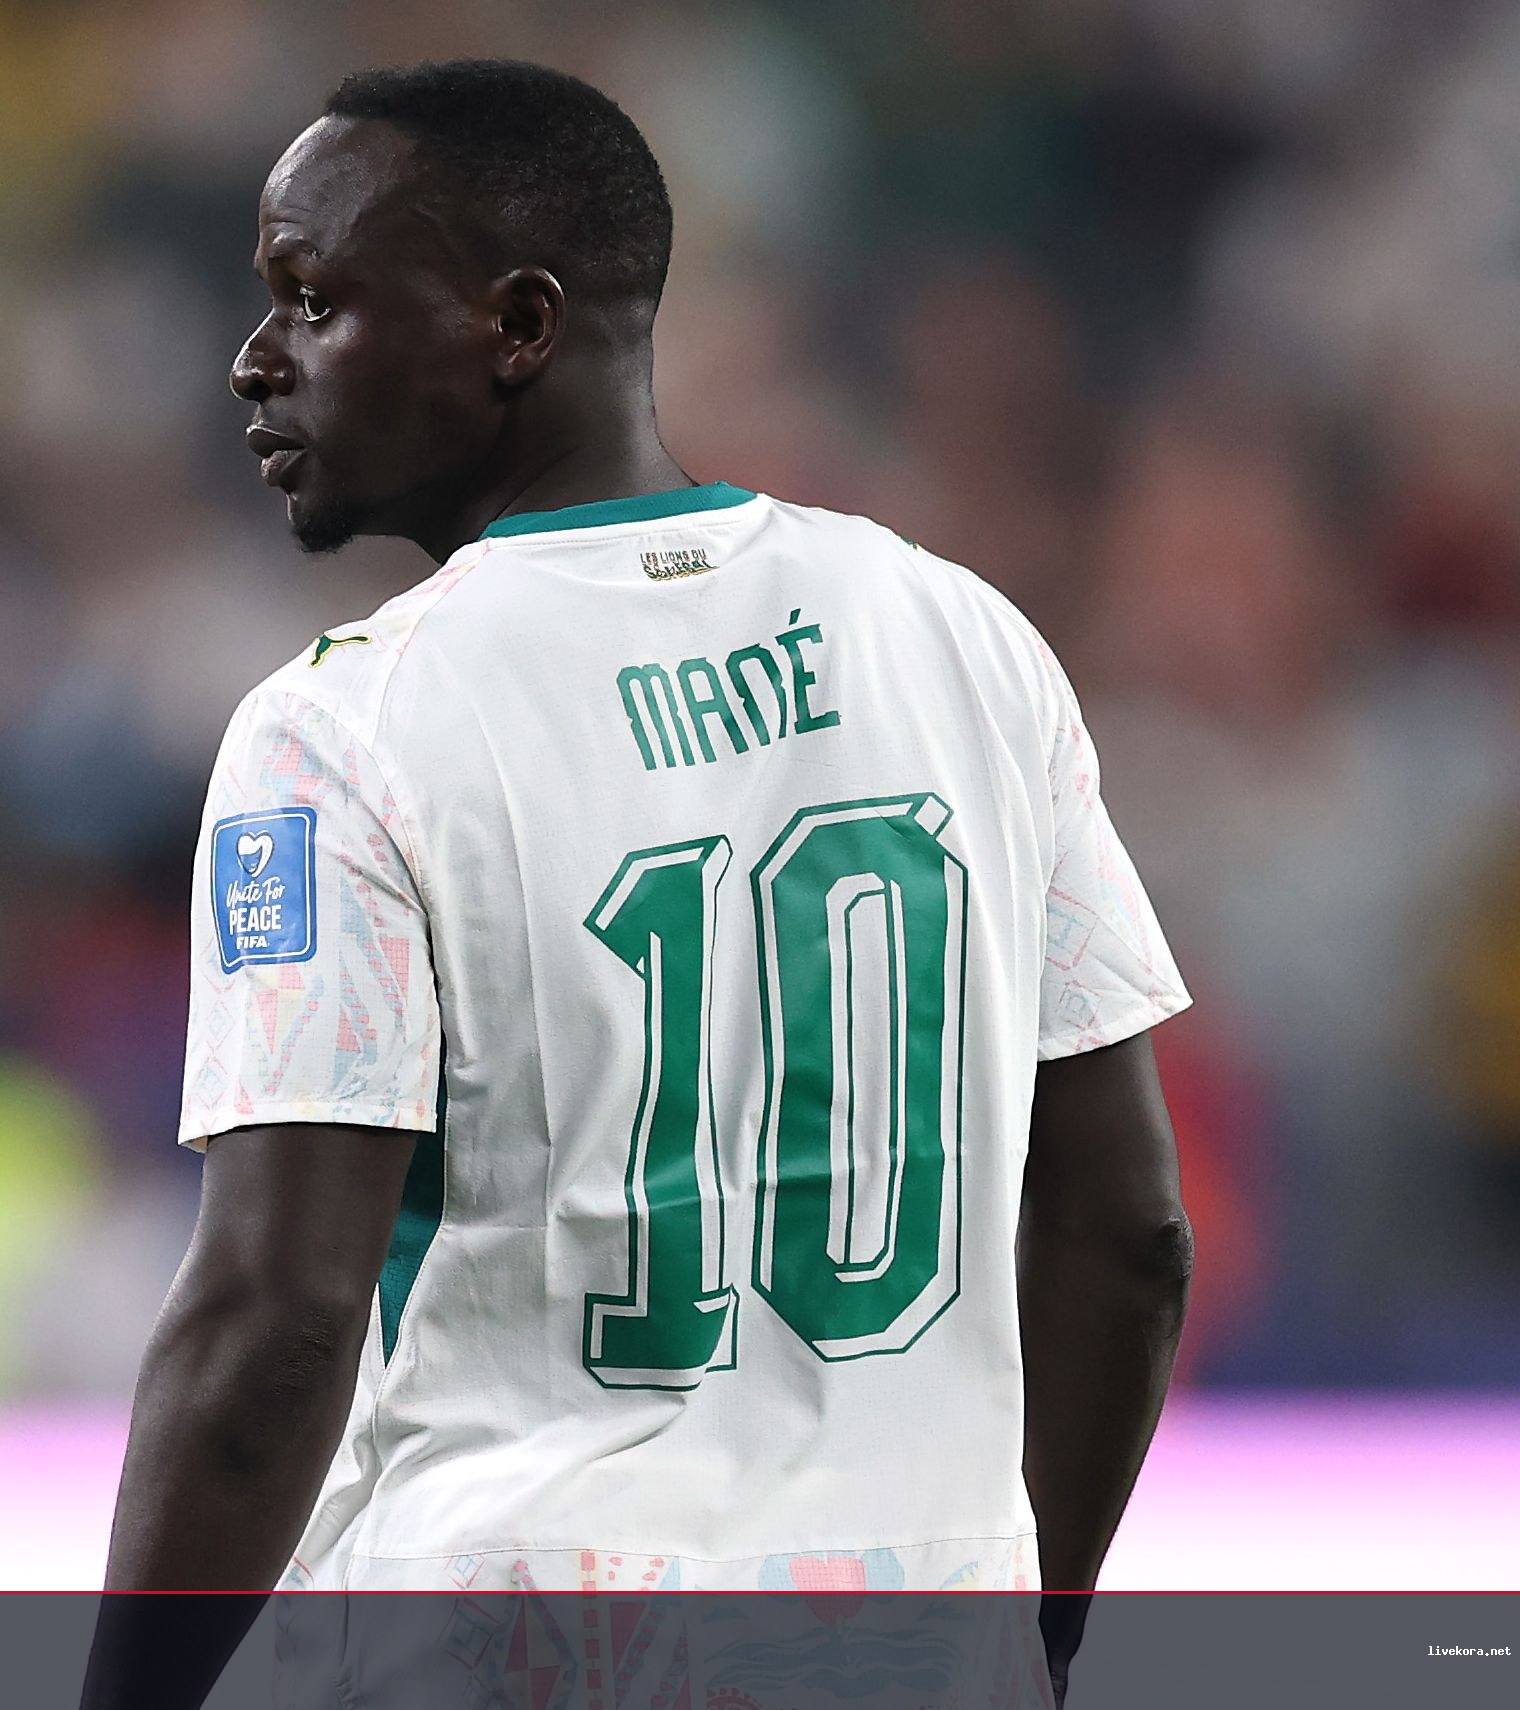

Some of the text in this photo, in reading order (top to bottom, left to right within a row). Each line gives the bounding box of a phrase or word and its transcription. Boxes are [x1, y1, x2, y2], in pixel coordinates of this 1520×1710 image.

[640, 548, 707, 565] LES LIONS DU
[617, 609, 841, 770] MANÉ
[227, 876, 286, 909] Unite For
[229, 904, 282, 936] PEACE
[236, 935, 268, 950] FIFA
[583, 791, 969, 1391] 10
